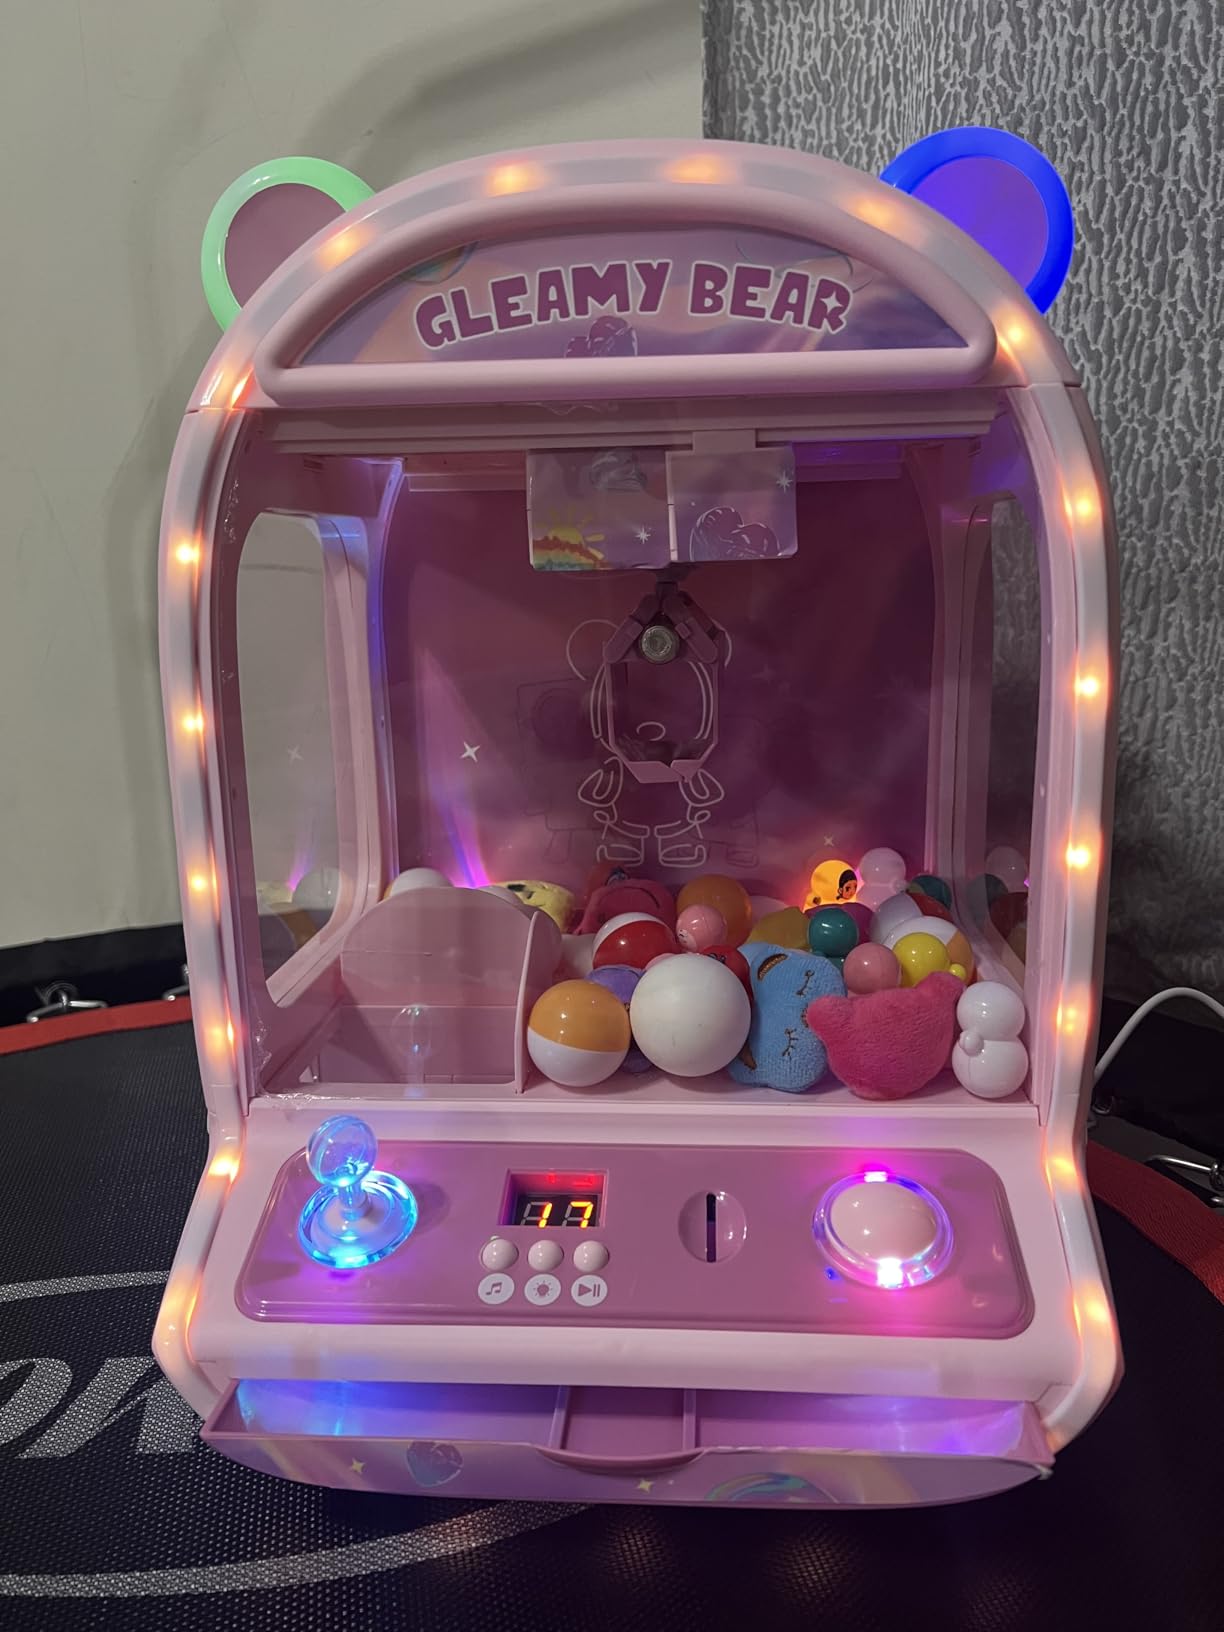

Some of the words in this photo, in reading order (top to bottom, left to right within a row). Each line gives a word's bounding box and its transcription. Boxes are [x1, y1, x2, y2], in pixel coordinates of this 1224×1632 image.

[414, 260, 673, 350] GLEAMY
[689, 261, 854, 334] BEAR
[537, 1201, 594, 1229] 17
